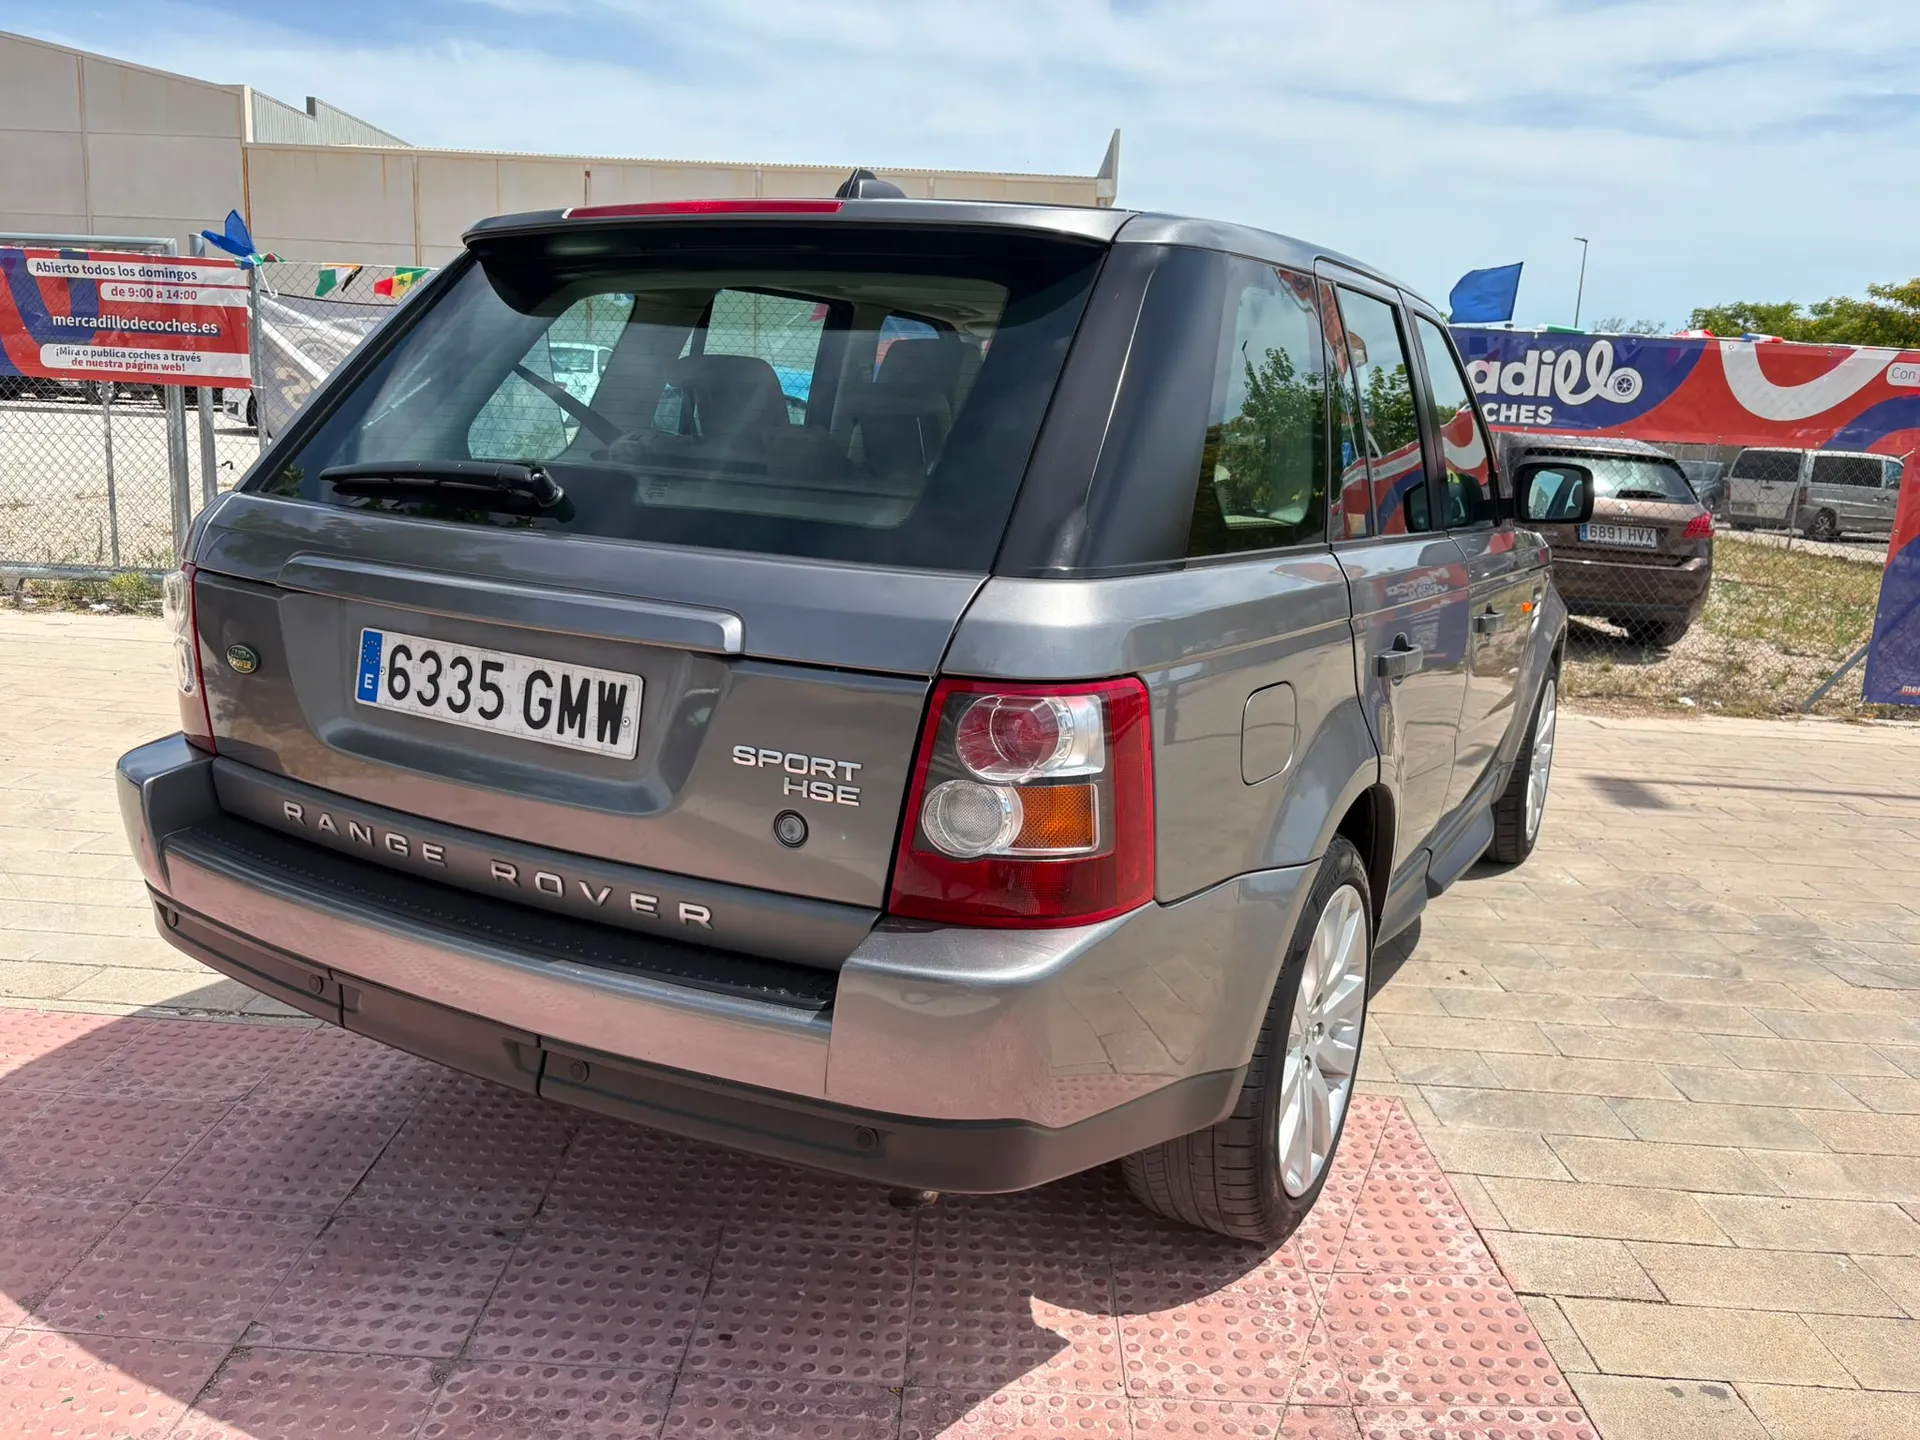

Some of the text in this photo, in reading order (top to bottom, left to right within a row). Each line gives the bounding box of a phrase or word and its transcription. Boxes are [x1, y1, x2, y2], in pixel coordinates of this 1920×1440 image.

[36, 262, 198, 282] Abierto todos los domingos
[111, 286, 198, 300] de 9:00 a 14:00
[52, 314, 218, 334] mercadillodecoches.es
[71, 357, 185, 372] de nuestra página web!
[91, 348, 126, 359] publica
[128, 350, 161, 360] coches
[163, 353, 169, 361] a
[171, 352, 202, 363] través
[1891, 367, 1916, 380] Con
[1589, 525, 1653, 543] 6891 HVX
[364, 673, 374, 689] E
[387, 644, 628, 745] 6335 GMW
[732, 744, 862, 782] SPORT
[783, 776, 861, 807] HSE
[283, 800, 714, 931] RANGE ROVER
